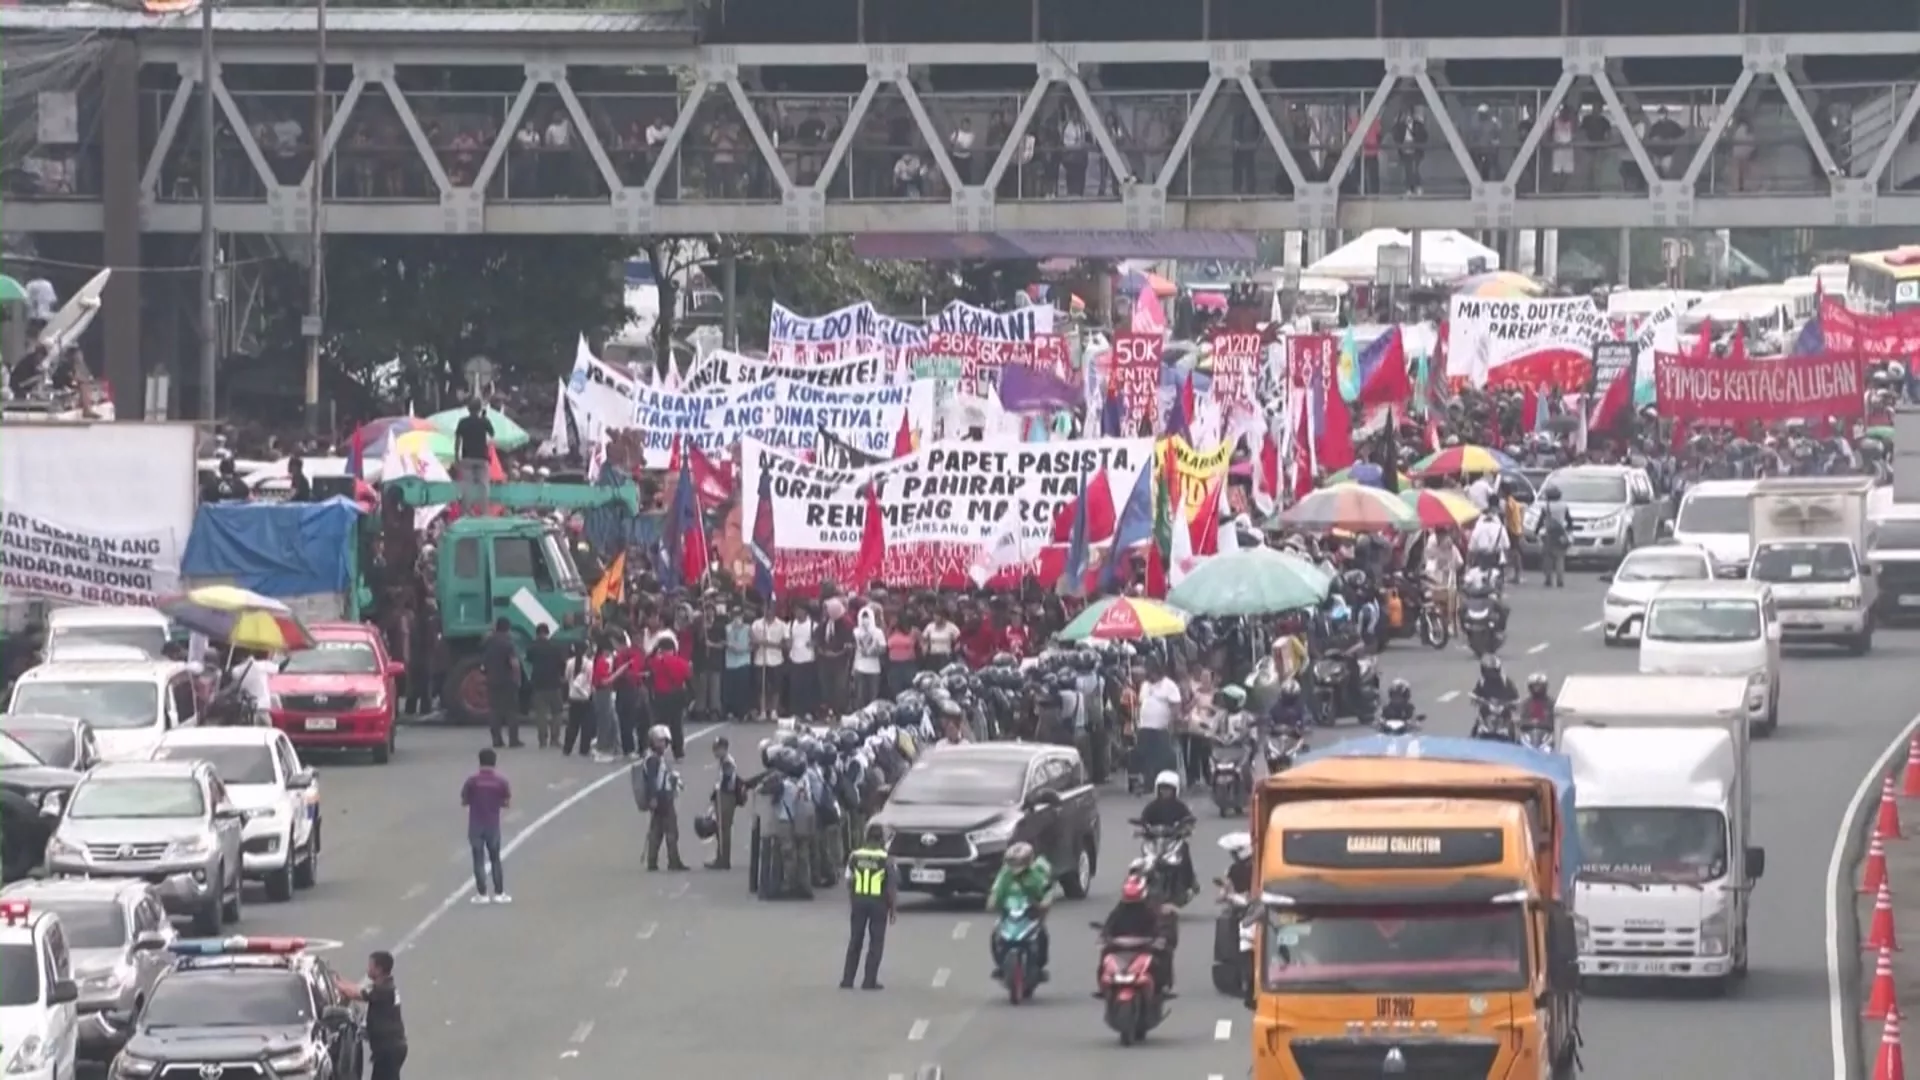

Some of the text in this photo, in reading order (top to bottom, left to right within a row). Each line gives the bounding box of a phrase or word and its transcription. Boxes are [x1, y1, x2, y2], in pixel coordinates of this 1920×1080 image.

[1116, 338, 1161, 364] 50K
[1723, 360, 1858, 403] KATAGALUGAN
[723, 406, 764, 427] ANG
[927, 449, 1012, 477] PAPET,
[1018, 448, 1135, 474] PASISTA,
[902, 475, 1025, 499] PAHIRAP
[1040, 477, 1078, 496] NA
[806, 499, 952, 527] REHMENG
[0, 530, 90, 561] ALISTANG
[121, 538, 160, 554] ANG
[0, 572, 74, 596] ALISMO
